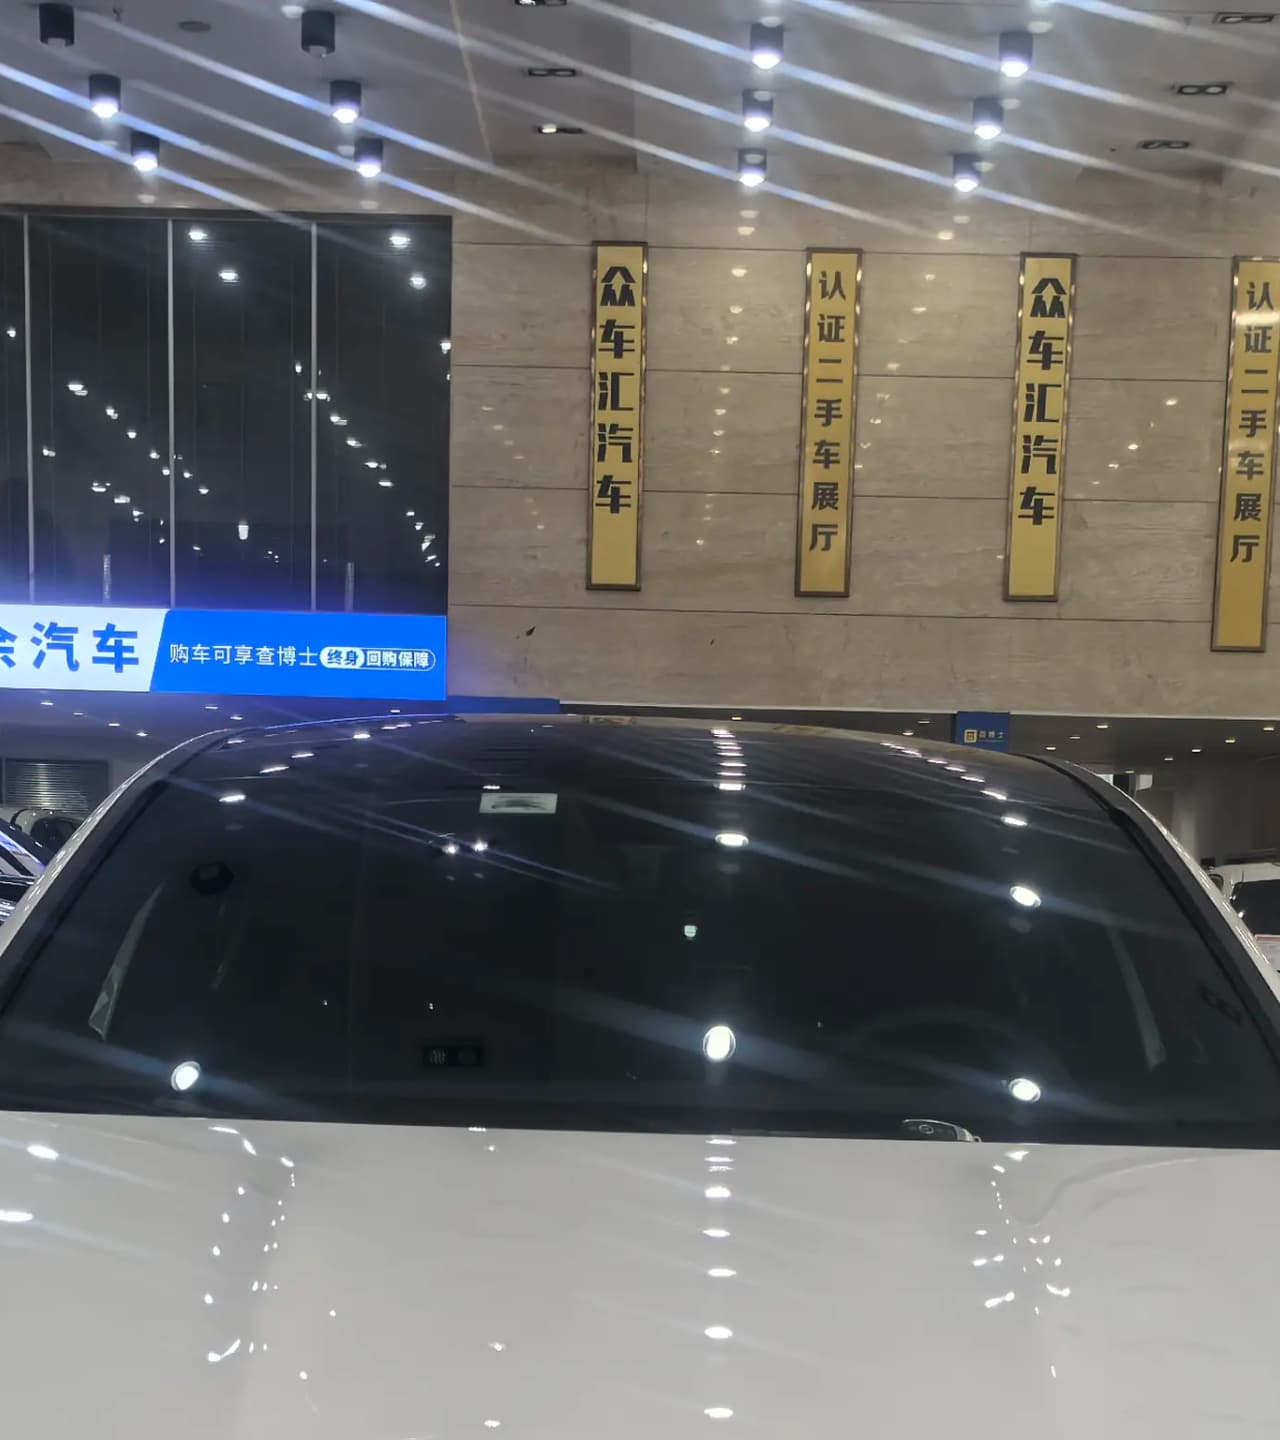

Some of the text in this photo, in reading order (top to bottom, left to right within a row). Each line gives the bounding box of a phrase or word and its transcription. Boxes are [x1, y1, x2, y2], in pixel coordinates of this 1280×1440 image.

[595, 266, 636, 514] 众车汇汽车
[809, 271, 846, 551] 认证二手车展厅
[1018, 278, 1067, 525] 众车汇汽车
[1230, 282, 1274, 563] 认证二手车展厅
